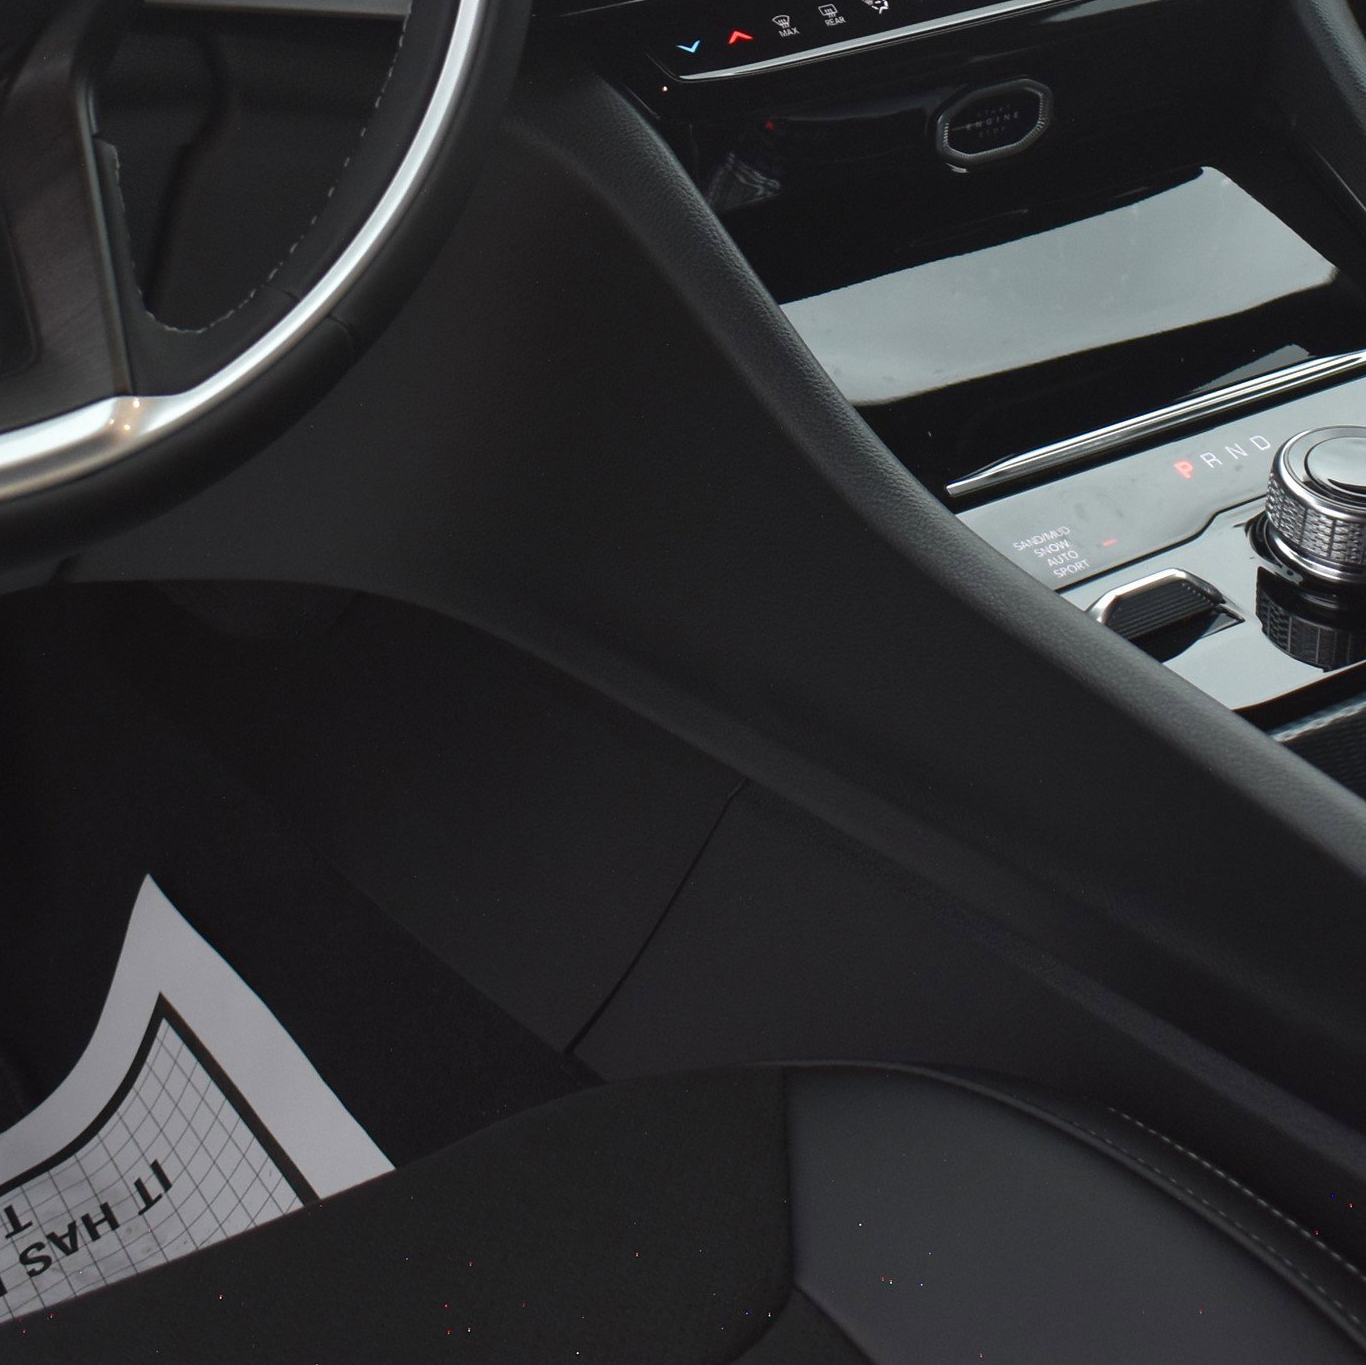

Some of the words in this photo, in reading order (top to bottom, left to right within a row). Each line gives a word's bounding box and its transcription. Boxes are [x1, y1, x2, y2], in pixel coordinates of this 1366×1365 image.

[824, 15, 847, 27] REAR
[779, 26, 801, 38] MAX
[966, 111, 1020, 131] ENGINE
[1173, 459, 1194, 479] P
[1199, 451, 1223, 469] R
[1224, 442, 1249, 460] N
[1249, 434, 1272, 451] D
[1012, 525, 1071, 552] SAND/MUD
[1033, 539, 1070, 558] SNOW
[1046, 549, 1079, 568] AUTO
[1052, 558, 1090, 579] SPORT
[134, 1158, 173, 1217] IT
[19, 1202, 123, 1279] HAS
